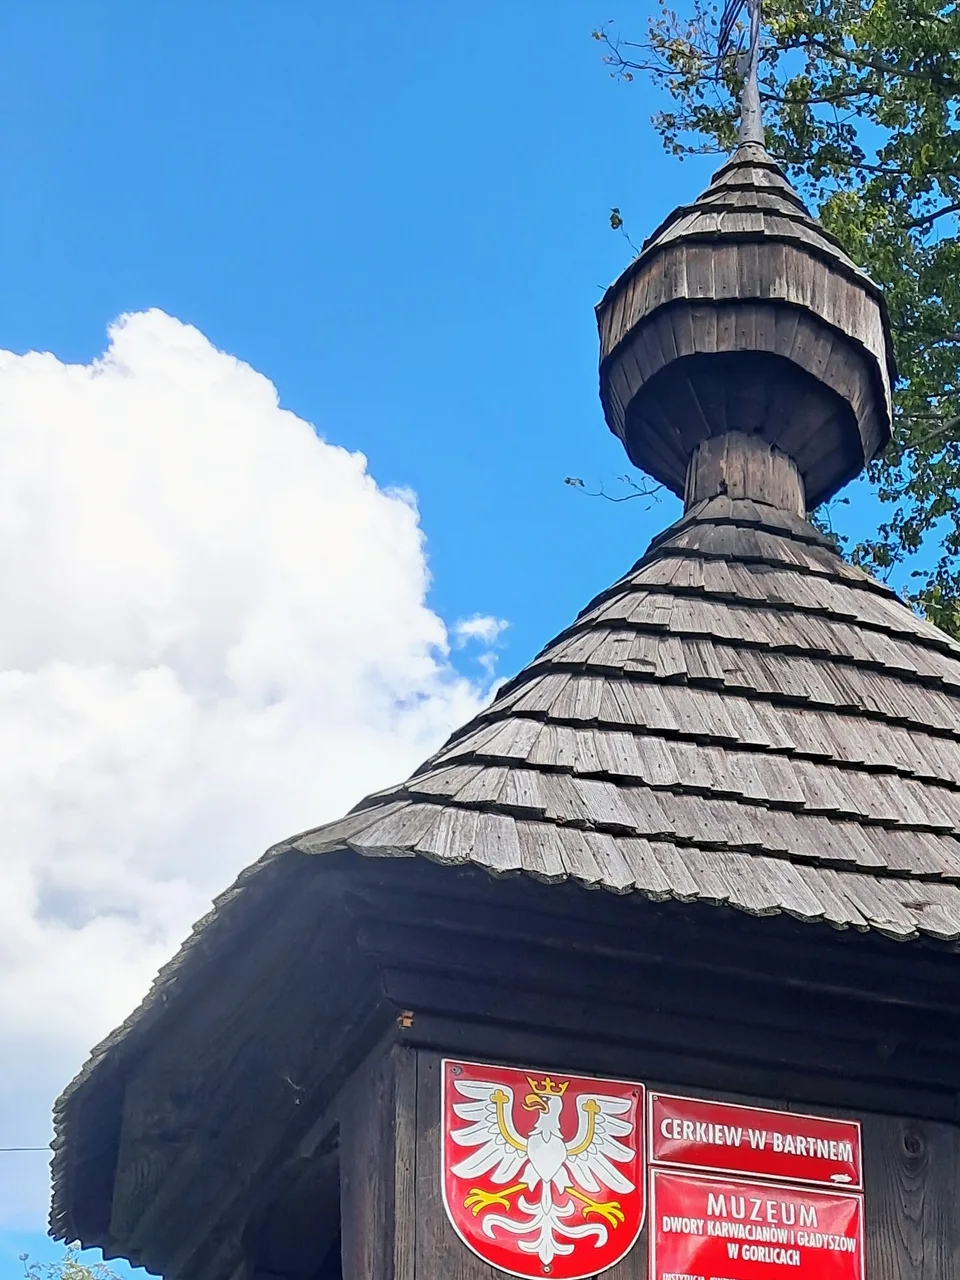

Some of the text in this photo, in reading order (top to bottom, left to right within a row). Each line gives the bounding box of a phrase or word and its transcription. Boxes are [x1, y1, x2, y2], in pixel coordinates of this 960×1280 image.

[660, 1118, 854, 1163] CERKIEW W BARTNEM
[706, 1192, 818, 1228] MUZEUM
[662, 1216, 857, 1253] DWORY KARWACJANÓW I GŁADYSZÓW
[727, 1243, 801, 1266] W GORLICACH
